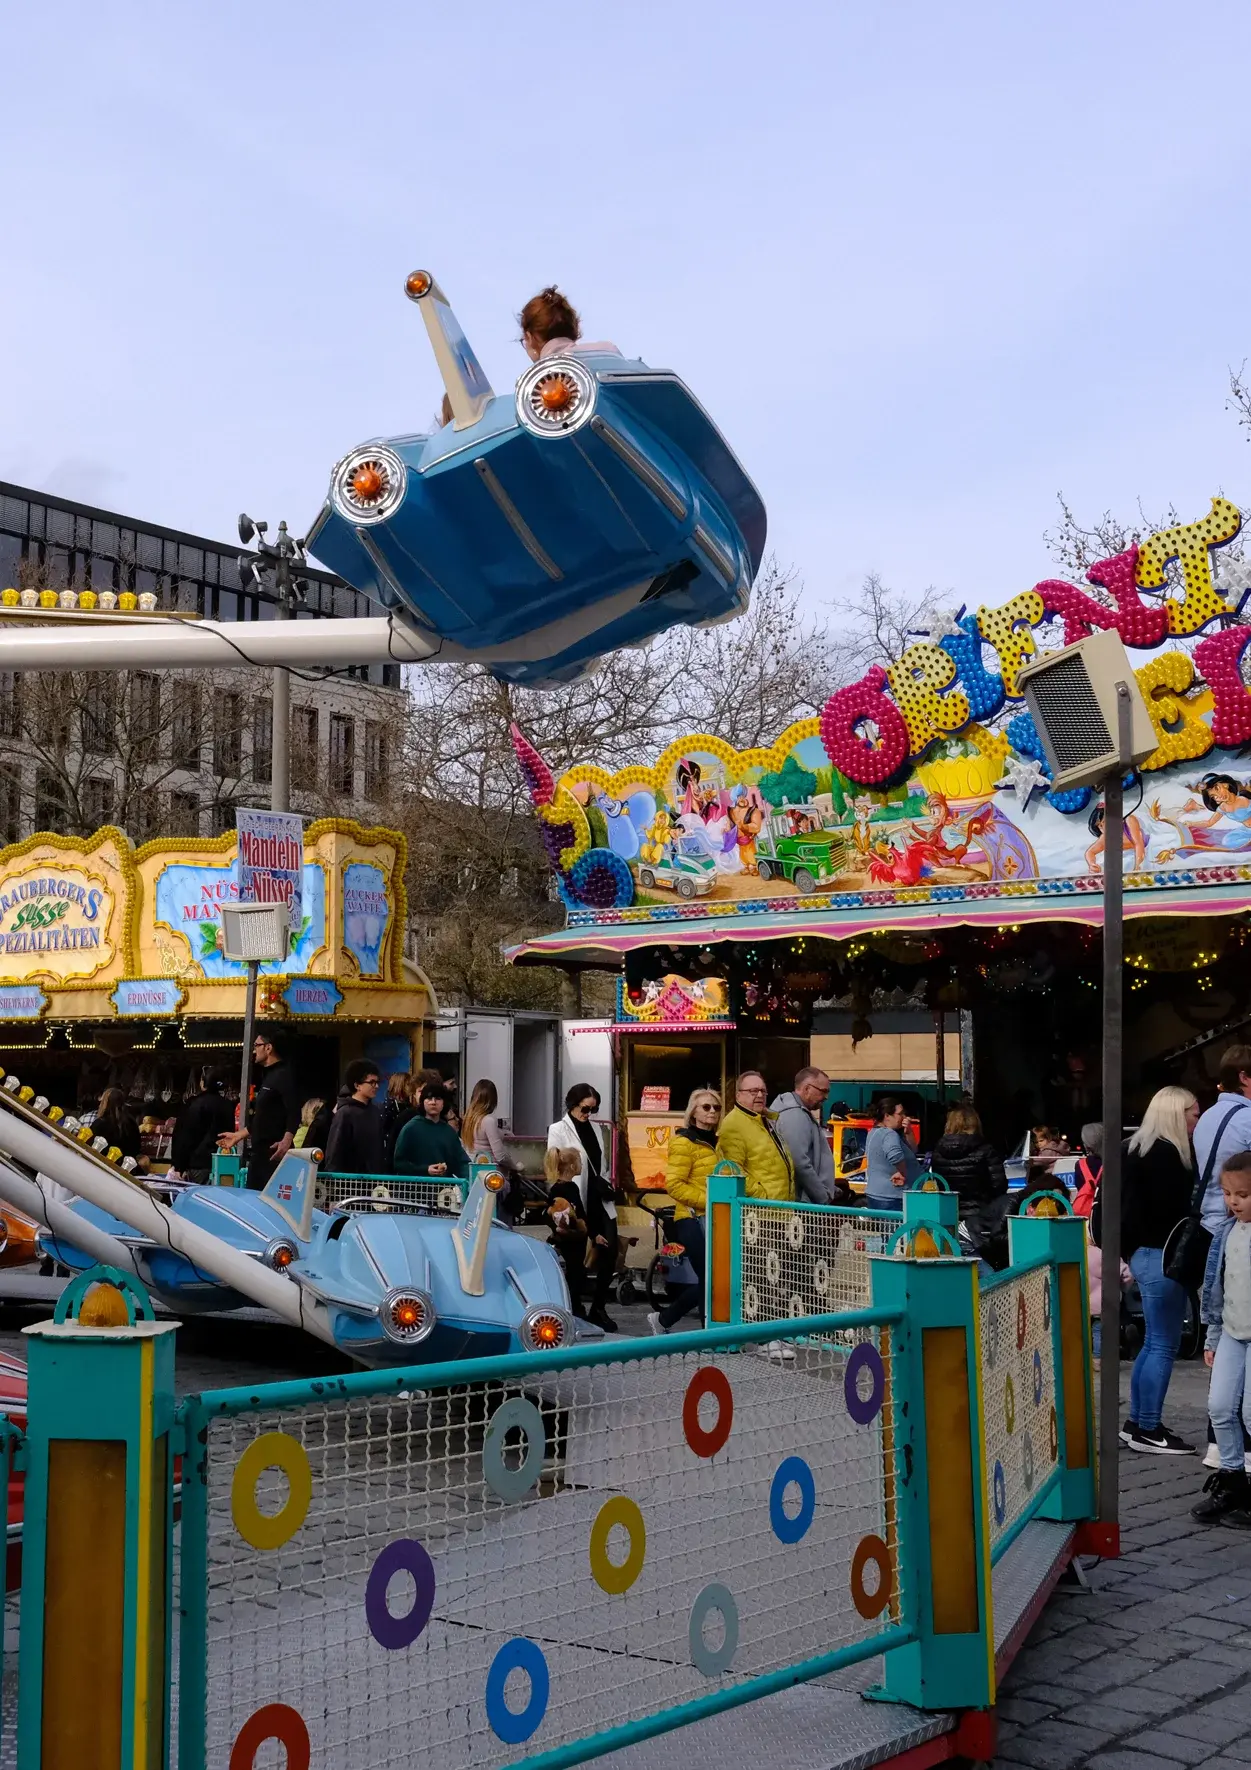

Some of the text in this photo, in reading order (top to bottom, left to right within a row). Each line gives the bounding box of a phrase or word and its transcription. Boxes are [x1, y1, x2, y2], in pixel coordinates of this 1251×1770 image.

[820, 497, 1242, 788] ORIENT
[241, 830, 299, 871] Mandeln
[0, 878, 103, 924] RAUBERGERS
[344, 889, 386, 902] ZUCKER
[127, 989, 167, 1006] ERDNÜSSE
[296, 989, 328, 1003] HERZEN
